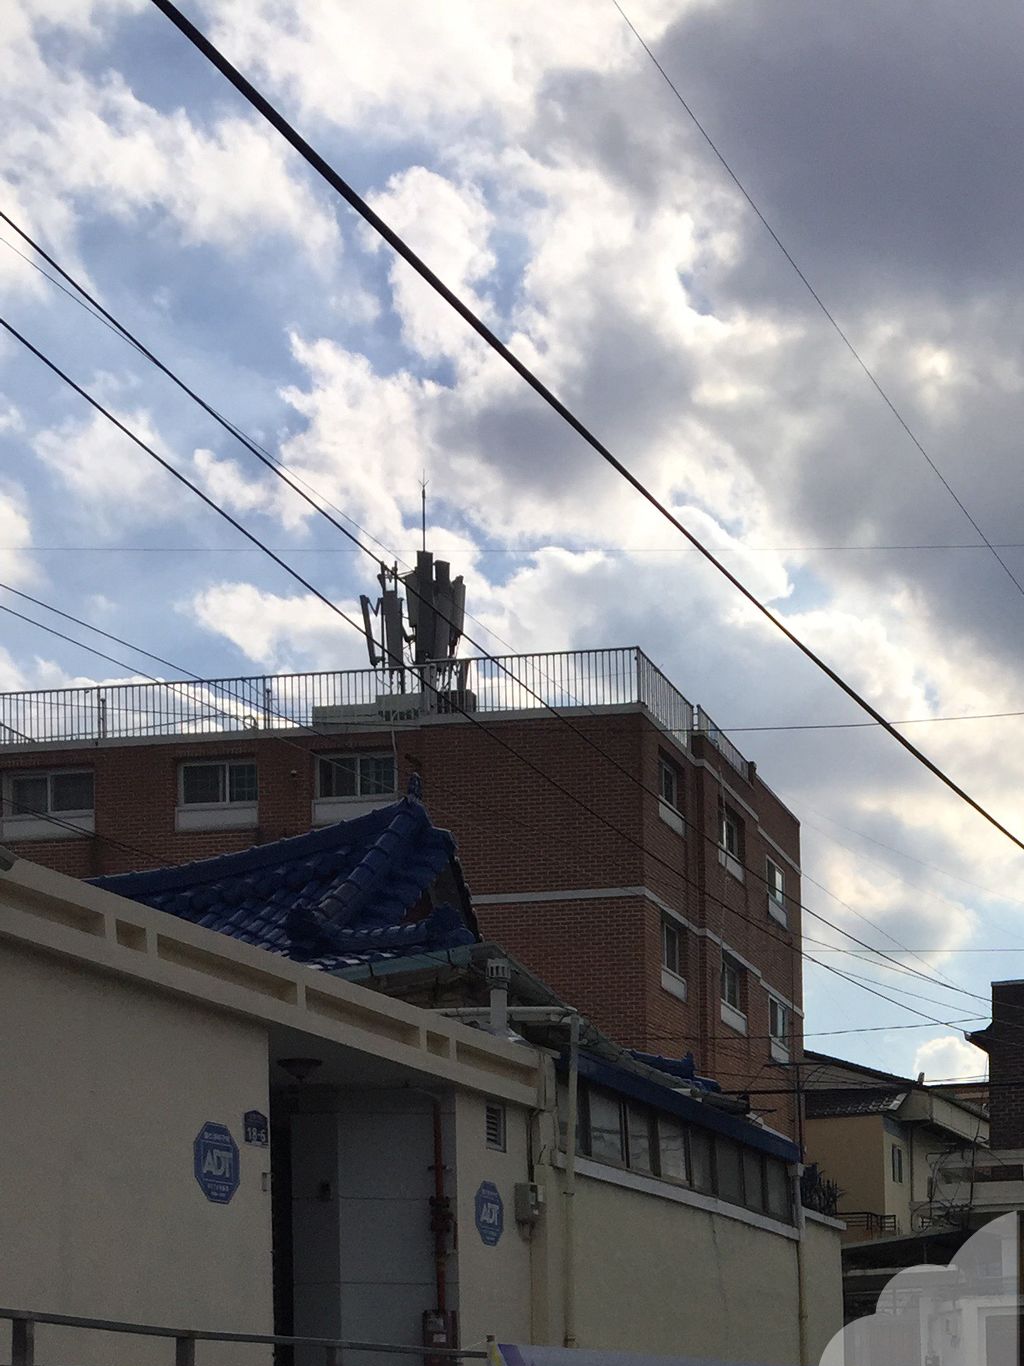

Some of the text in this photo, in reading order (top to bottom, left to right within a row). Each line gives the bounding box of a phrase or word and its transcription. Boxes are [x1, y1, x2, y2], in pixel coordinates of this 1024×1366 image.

[247, 1127, 266, 1142] 18-6
[203, 1149, 233, 1178] ADT
[480, 1202, 500, 1226] ADT
